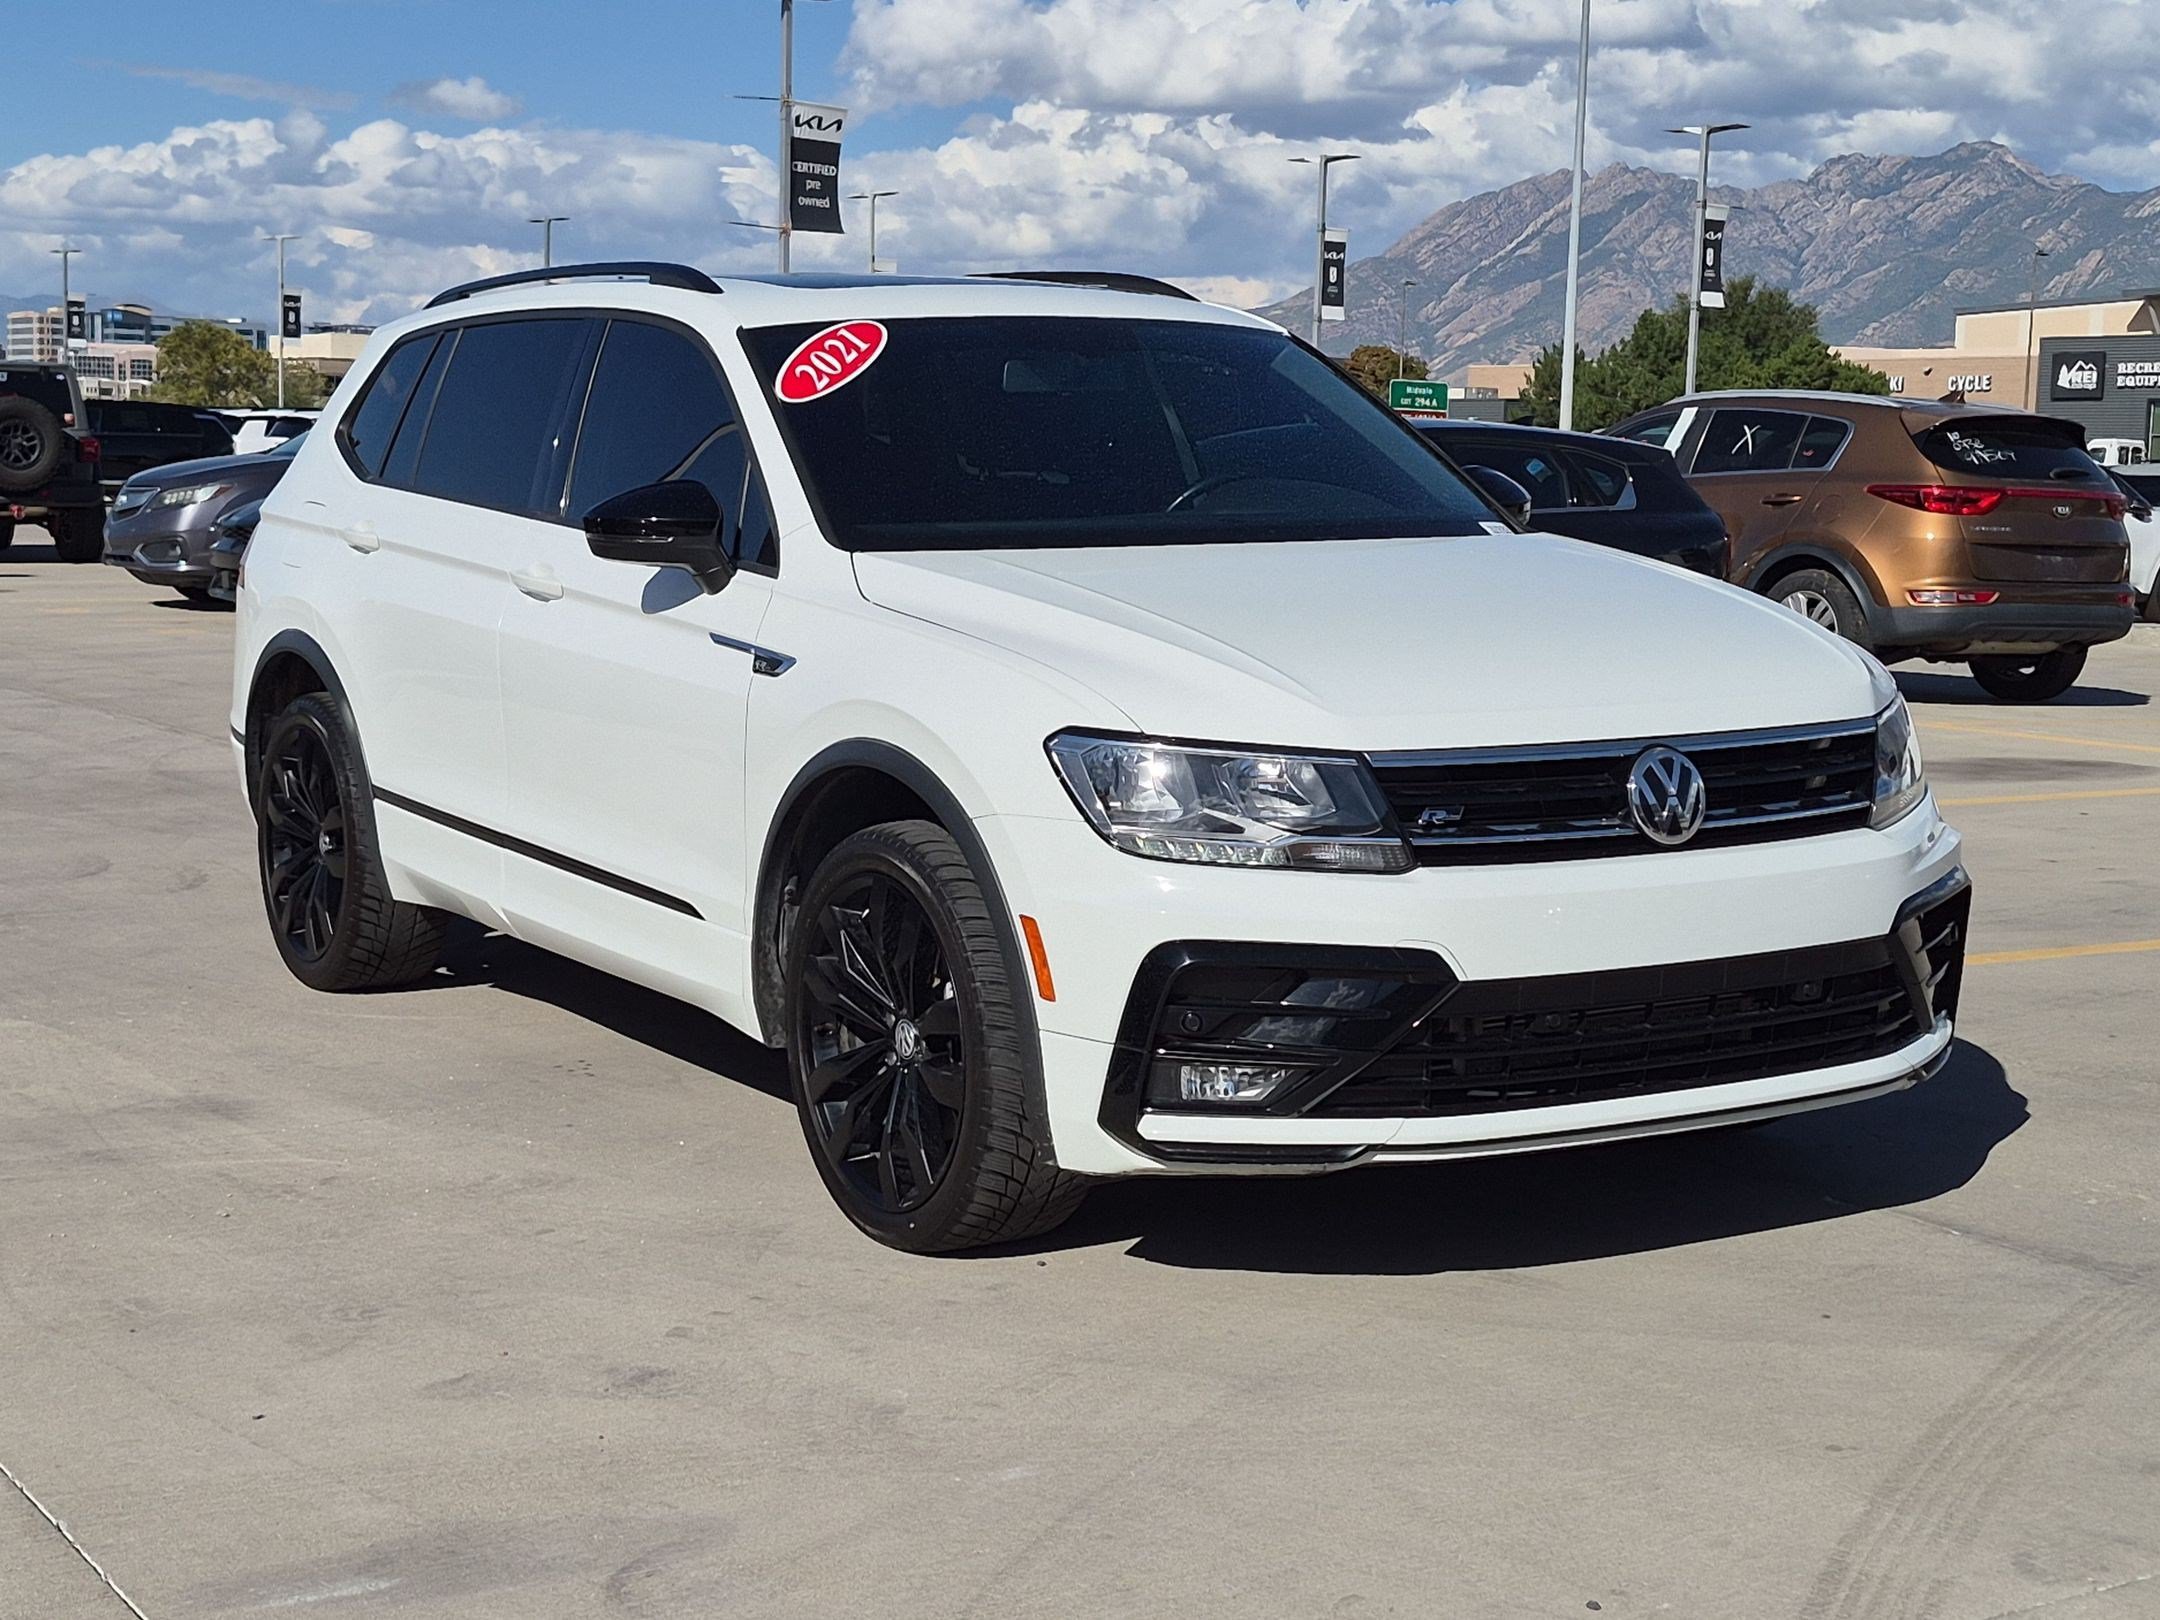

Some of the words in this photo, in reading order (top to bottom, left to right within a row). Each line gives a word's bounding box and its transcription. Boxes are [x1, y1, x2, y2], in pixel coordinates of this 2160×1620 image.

[794, 113, 844, 133] KIA
[791, 160, 838, 177] CERTIFIED
[805, 179, 822, 191] pre
[794, 327, 871, 392] 2021
[1888, 376, 1904, 392] KI
[1947, 374, 1992, 392] CYCLE
[2072, 370, 2098, 384] REI
